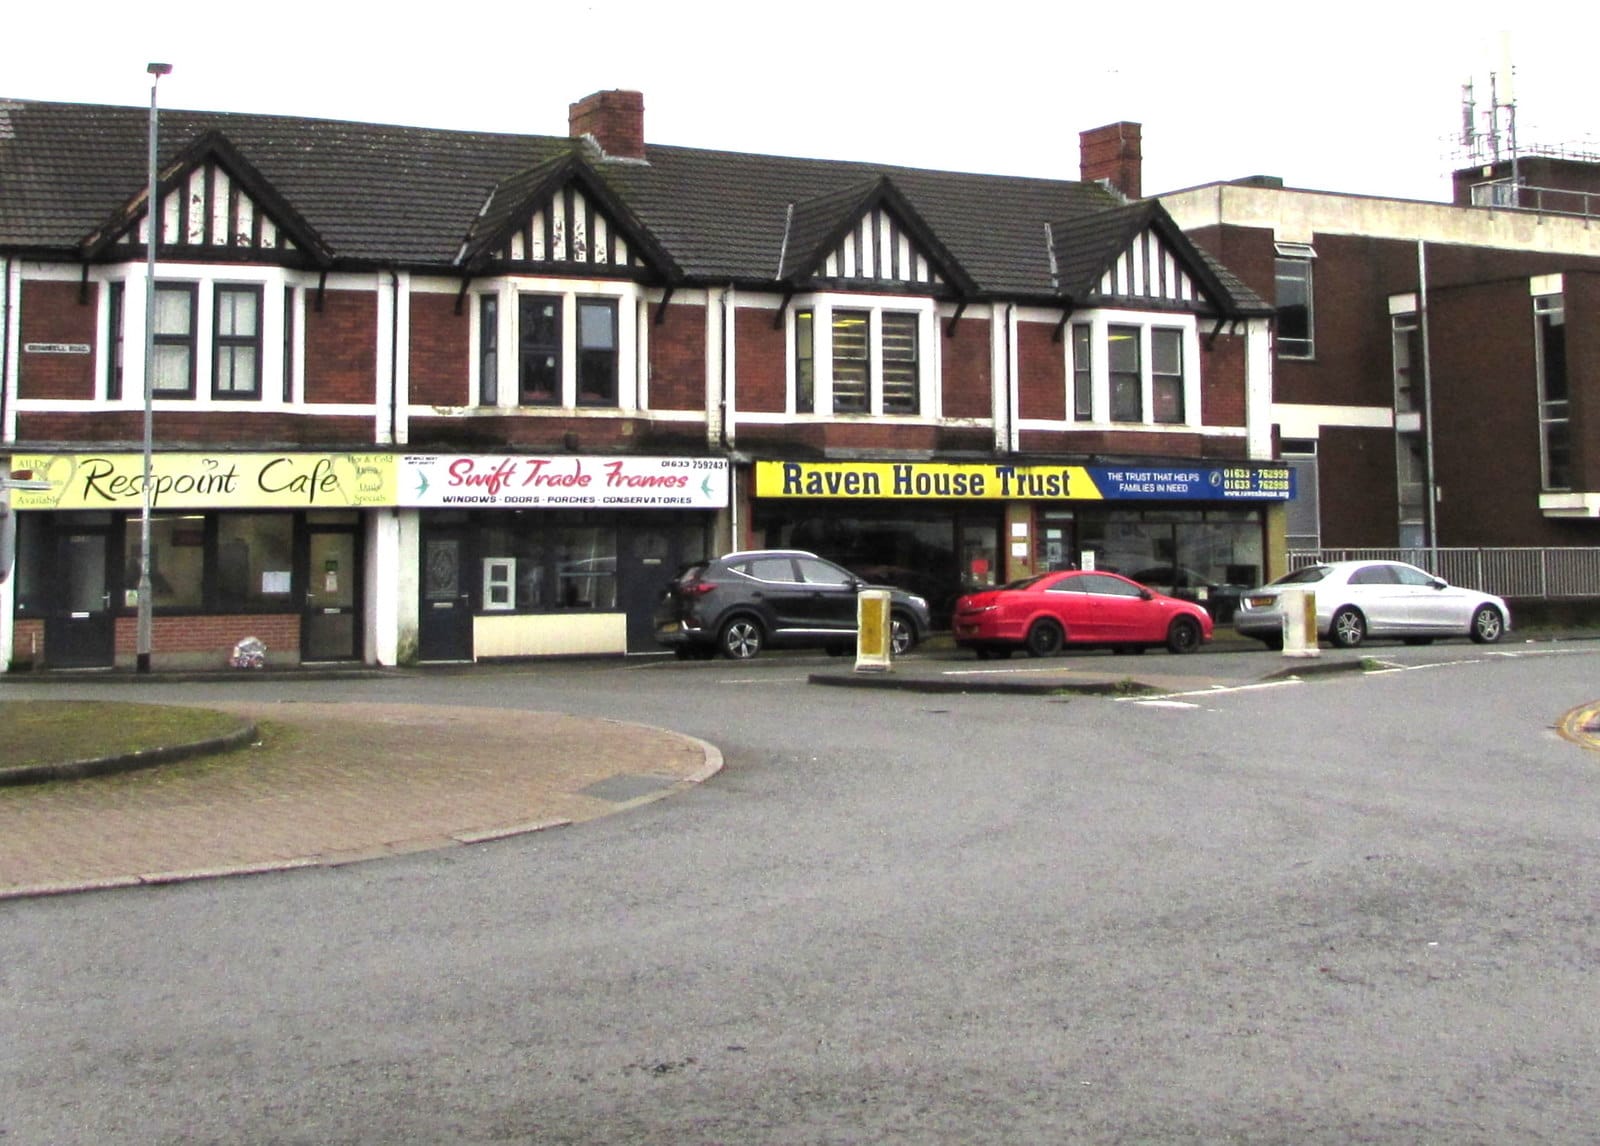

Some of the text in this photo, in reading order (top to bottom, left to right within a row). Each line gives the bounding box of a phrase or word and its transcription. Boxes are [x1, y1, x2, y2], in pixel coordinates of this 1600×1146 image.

[19, 459, 32, 468] All
[661, 460, 690, 468] 01633
[448, 458, 689, 495] Swift Trade Frames
[1107, 472, 1200, 482] THE TRUST THAT HELPS
[1223, 469, 1250, 478] 01633
[782, 462, 1070, 496] Raven House Trust
[1119, 484, 1188, 493] FAMILIES IN NEED
[1223, 480, 1250, 489] 01633
[442, 495, 497, 503] WINDOWS
[603, 496, 692, 504] CONSERVATORIES
